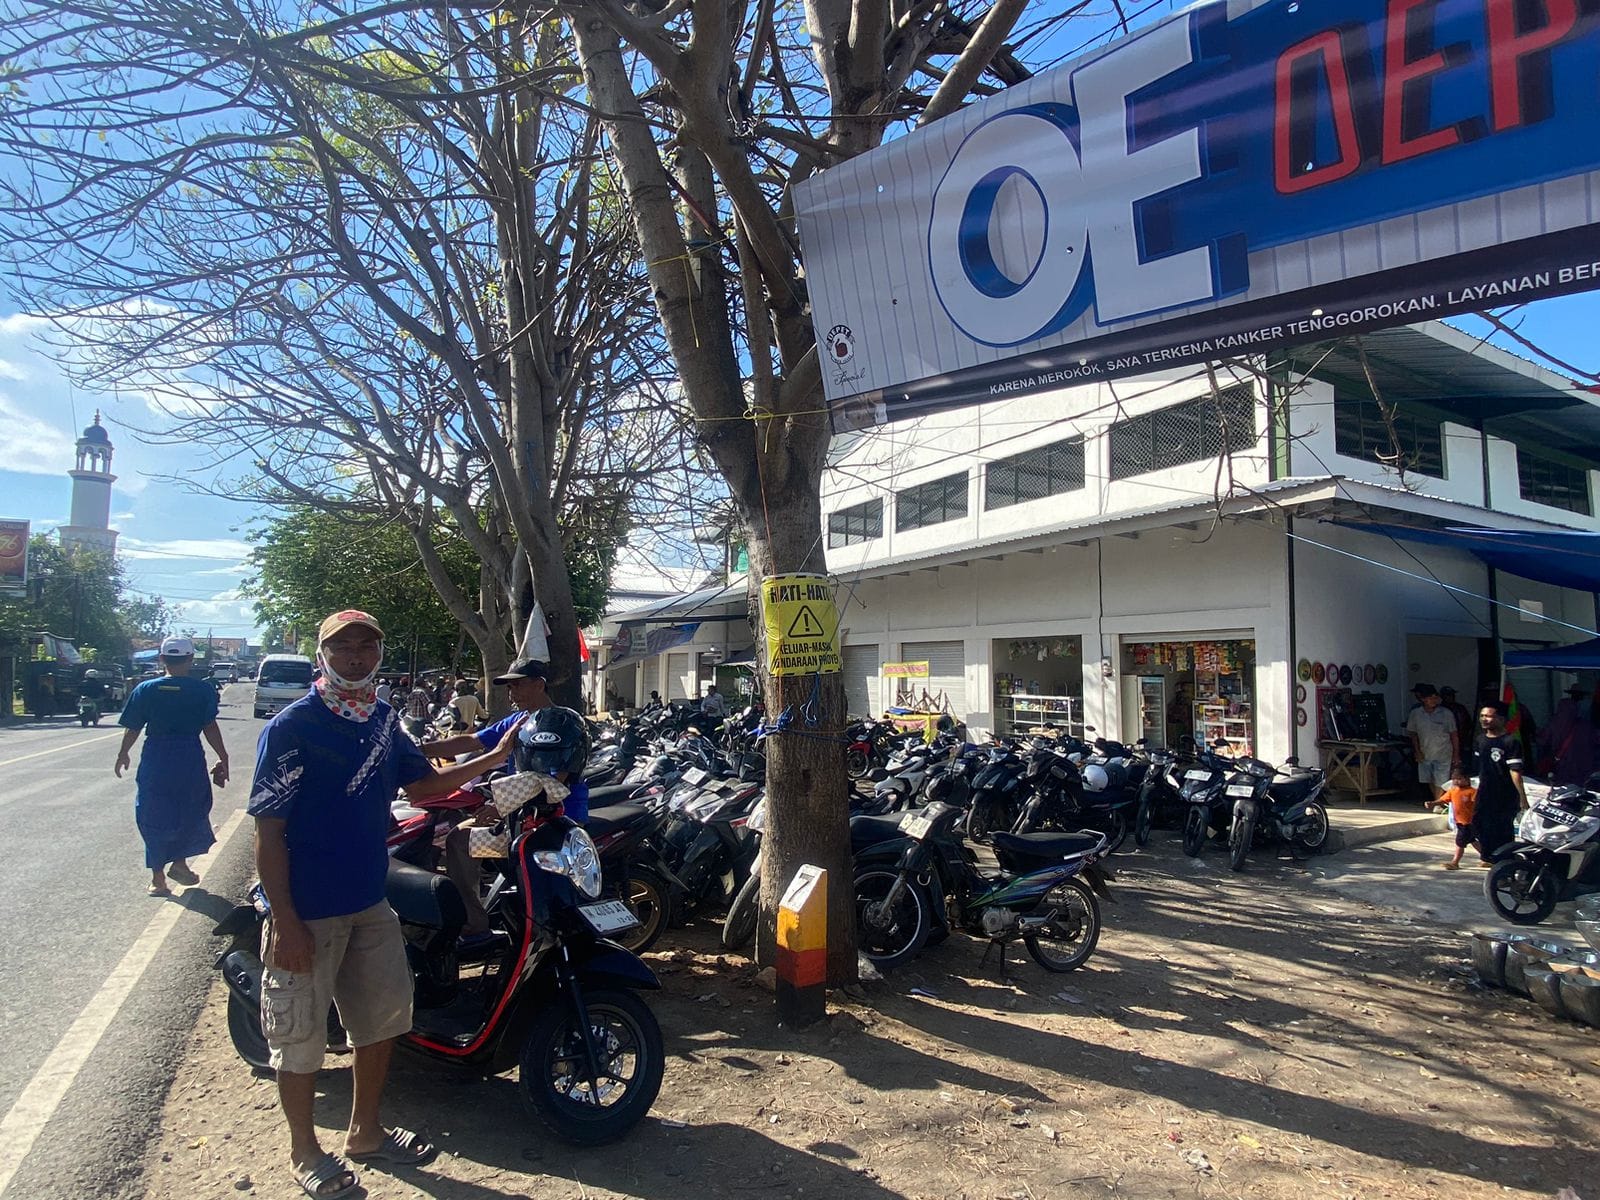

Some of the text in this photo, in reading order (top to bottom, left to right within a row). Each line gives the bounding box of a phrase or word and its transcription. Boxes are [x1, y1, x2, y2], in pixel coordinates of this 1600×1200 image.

[989, 261, 1600, 395] KARENA MEROKOK, SAYA TERKENA KANKER TENGGOROKAN. LAYANAN BER
